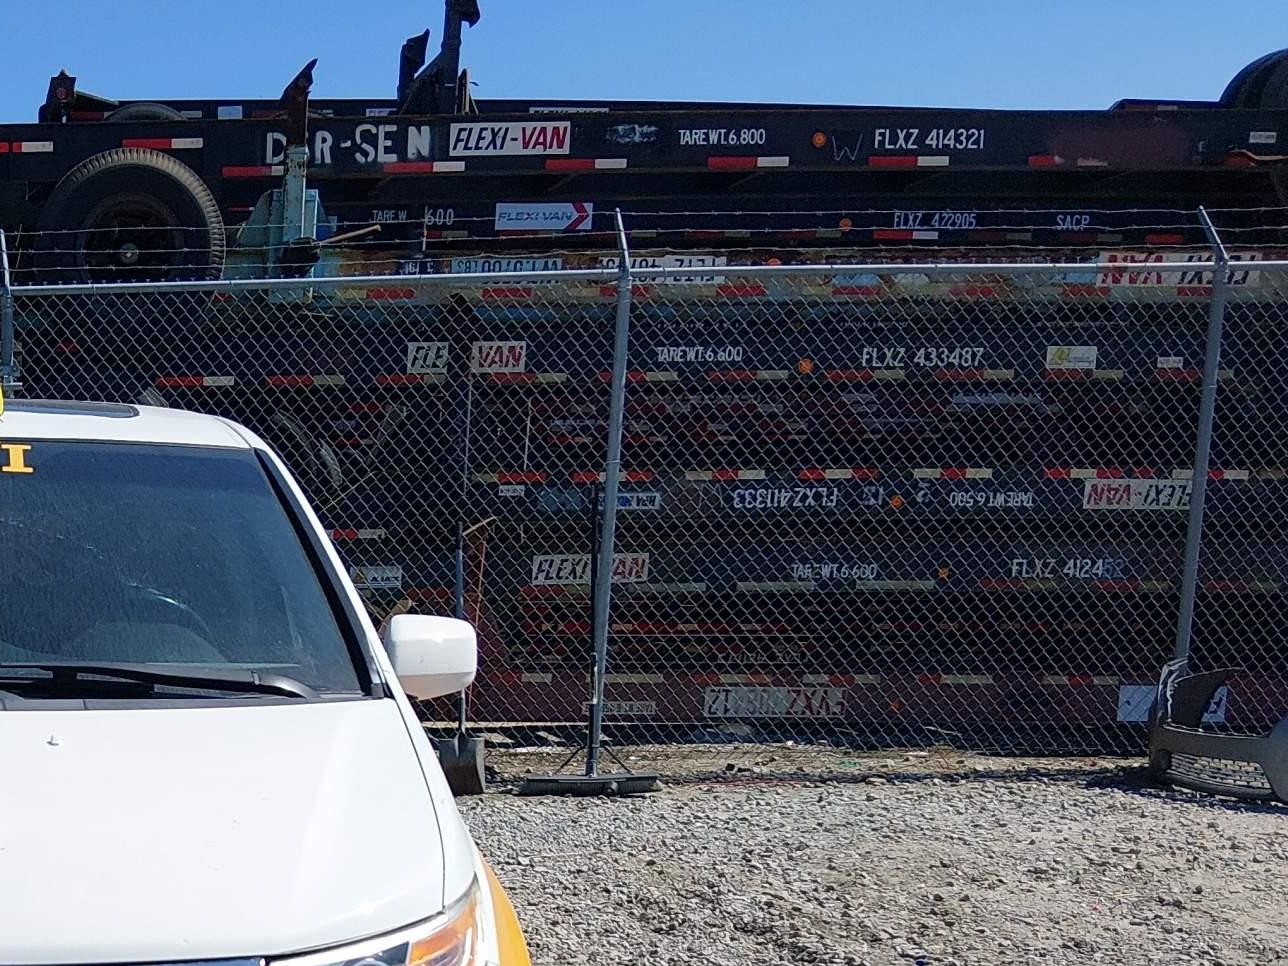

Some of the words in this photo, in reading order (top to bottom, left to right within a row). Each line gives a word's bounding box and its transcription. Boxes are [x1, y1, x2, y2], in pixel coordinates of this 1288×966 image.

[452, 126, 568, 150] FLEXI-VAN
[874, 128, 919, 149] FLXZ
[925, 128, 985, 149] 414321
[893, 212, 922, 229] FLXZ
[1056, 215, 1091, 231] SACP
[862, 347, 906, 367] FLXZ
[914, 347, 985, 367] 433487
[1011, 559, 1057, 578] FLXZ
